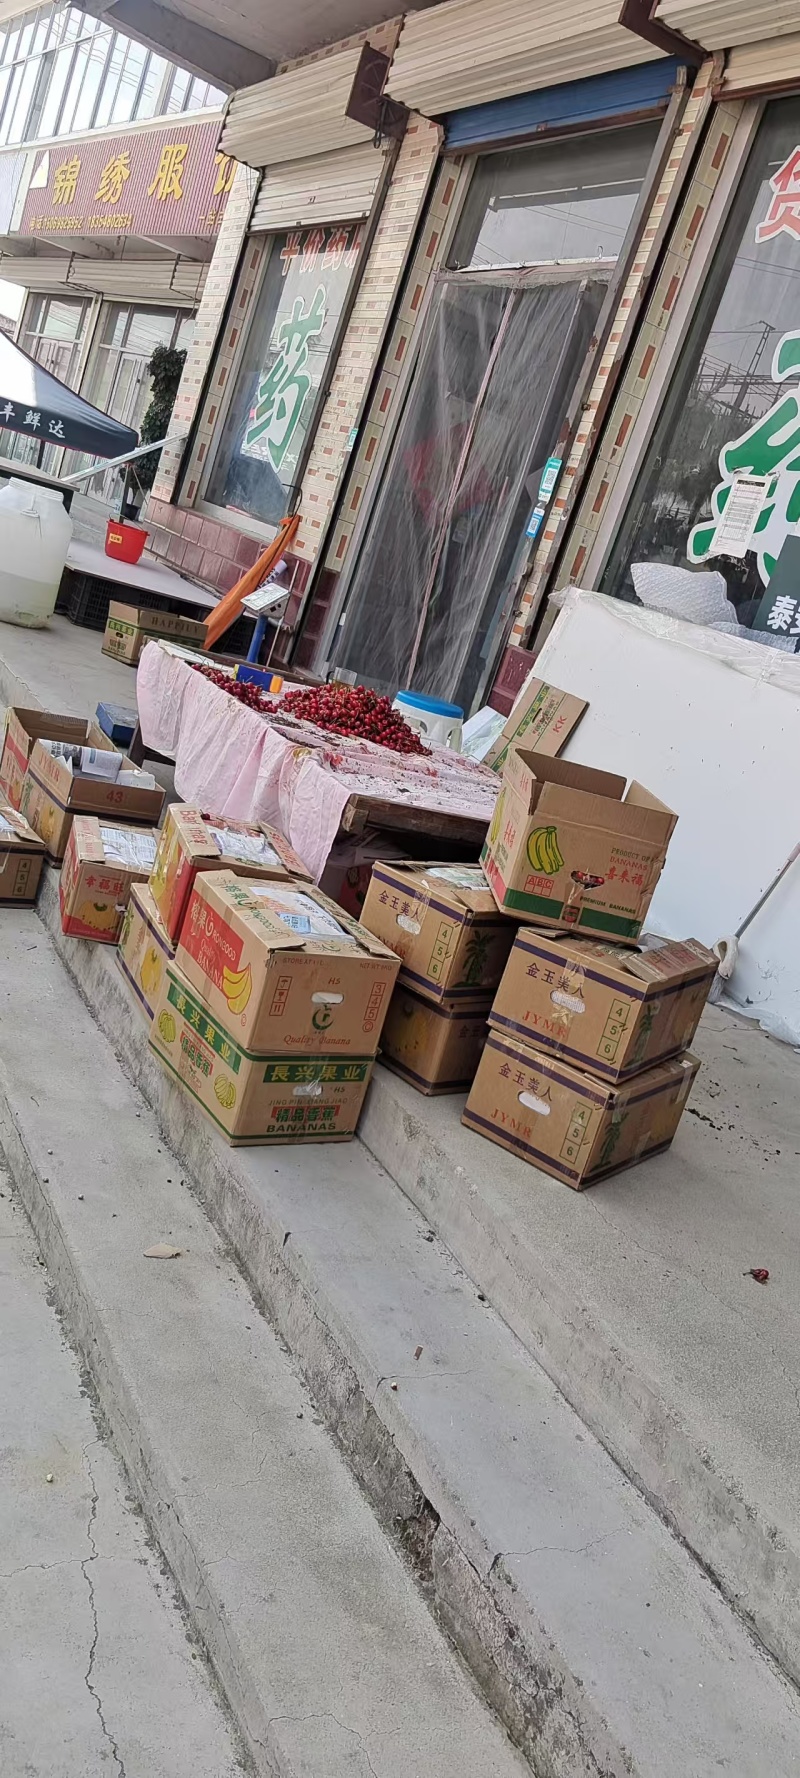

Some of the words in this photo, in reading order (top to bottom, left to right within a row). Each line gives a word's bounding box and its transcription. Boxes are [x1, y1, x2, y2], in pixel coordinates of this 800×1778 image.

[245, 284, 327, 474] 药
[106, 790, 124, 803] 43
[525, 962, 585, 999] 金玉美人
[615, 1007, 623, 1018] 4
[609, 1025, 617, 1036] 5
[283, 1034, 315, 1046] Quality
[604, 1044, 611, 1054] 6
[498, 1062, 552, 1101] 金玉美人
[266, 1122, 336, 1133] BANANAS
